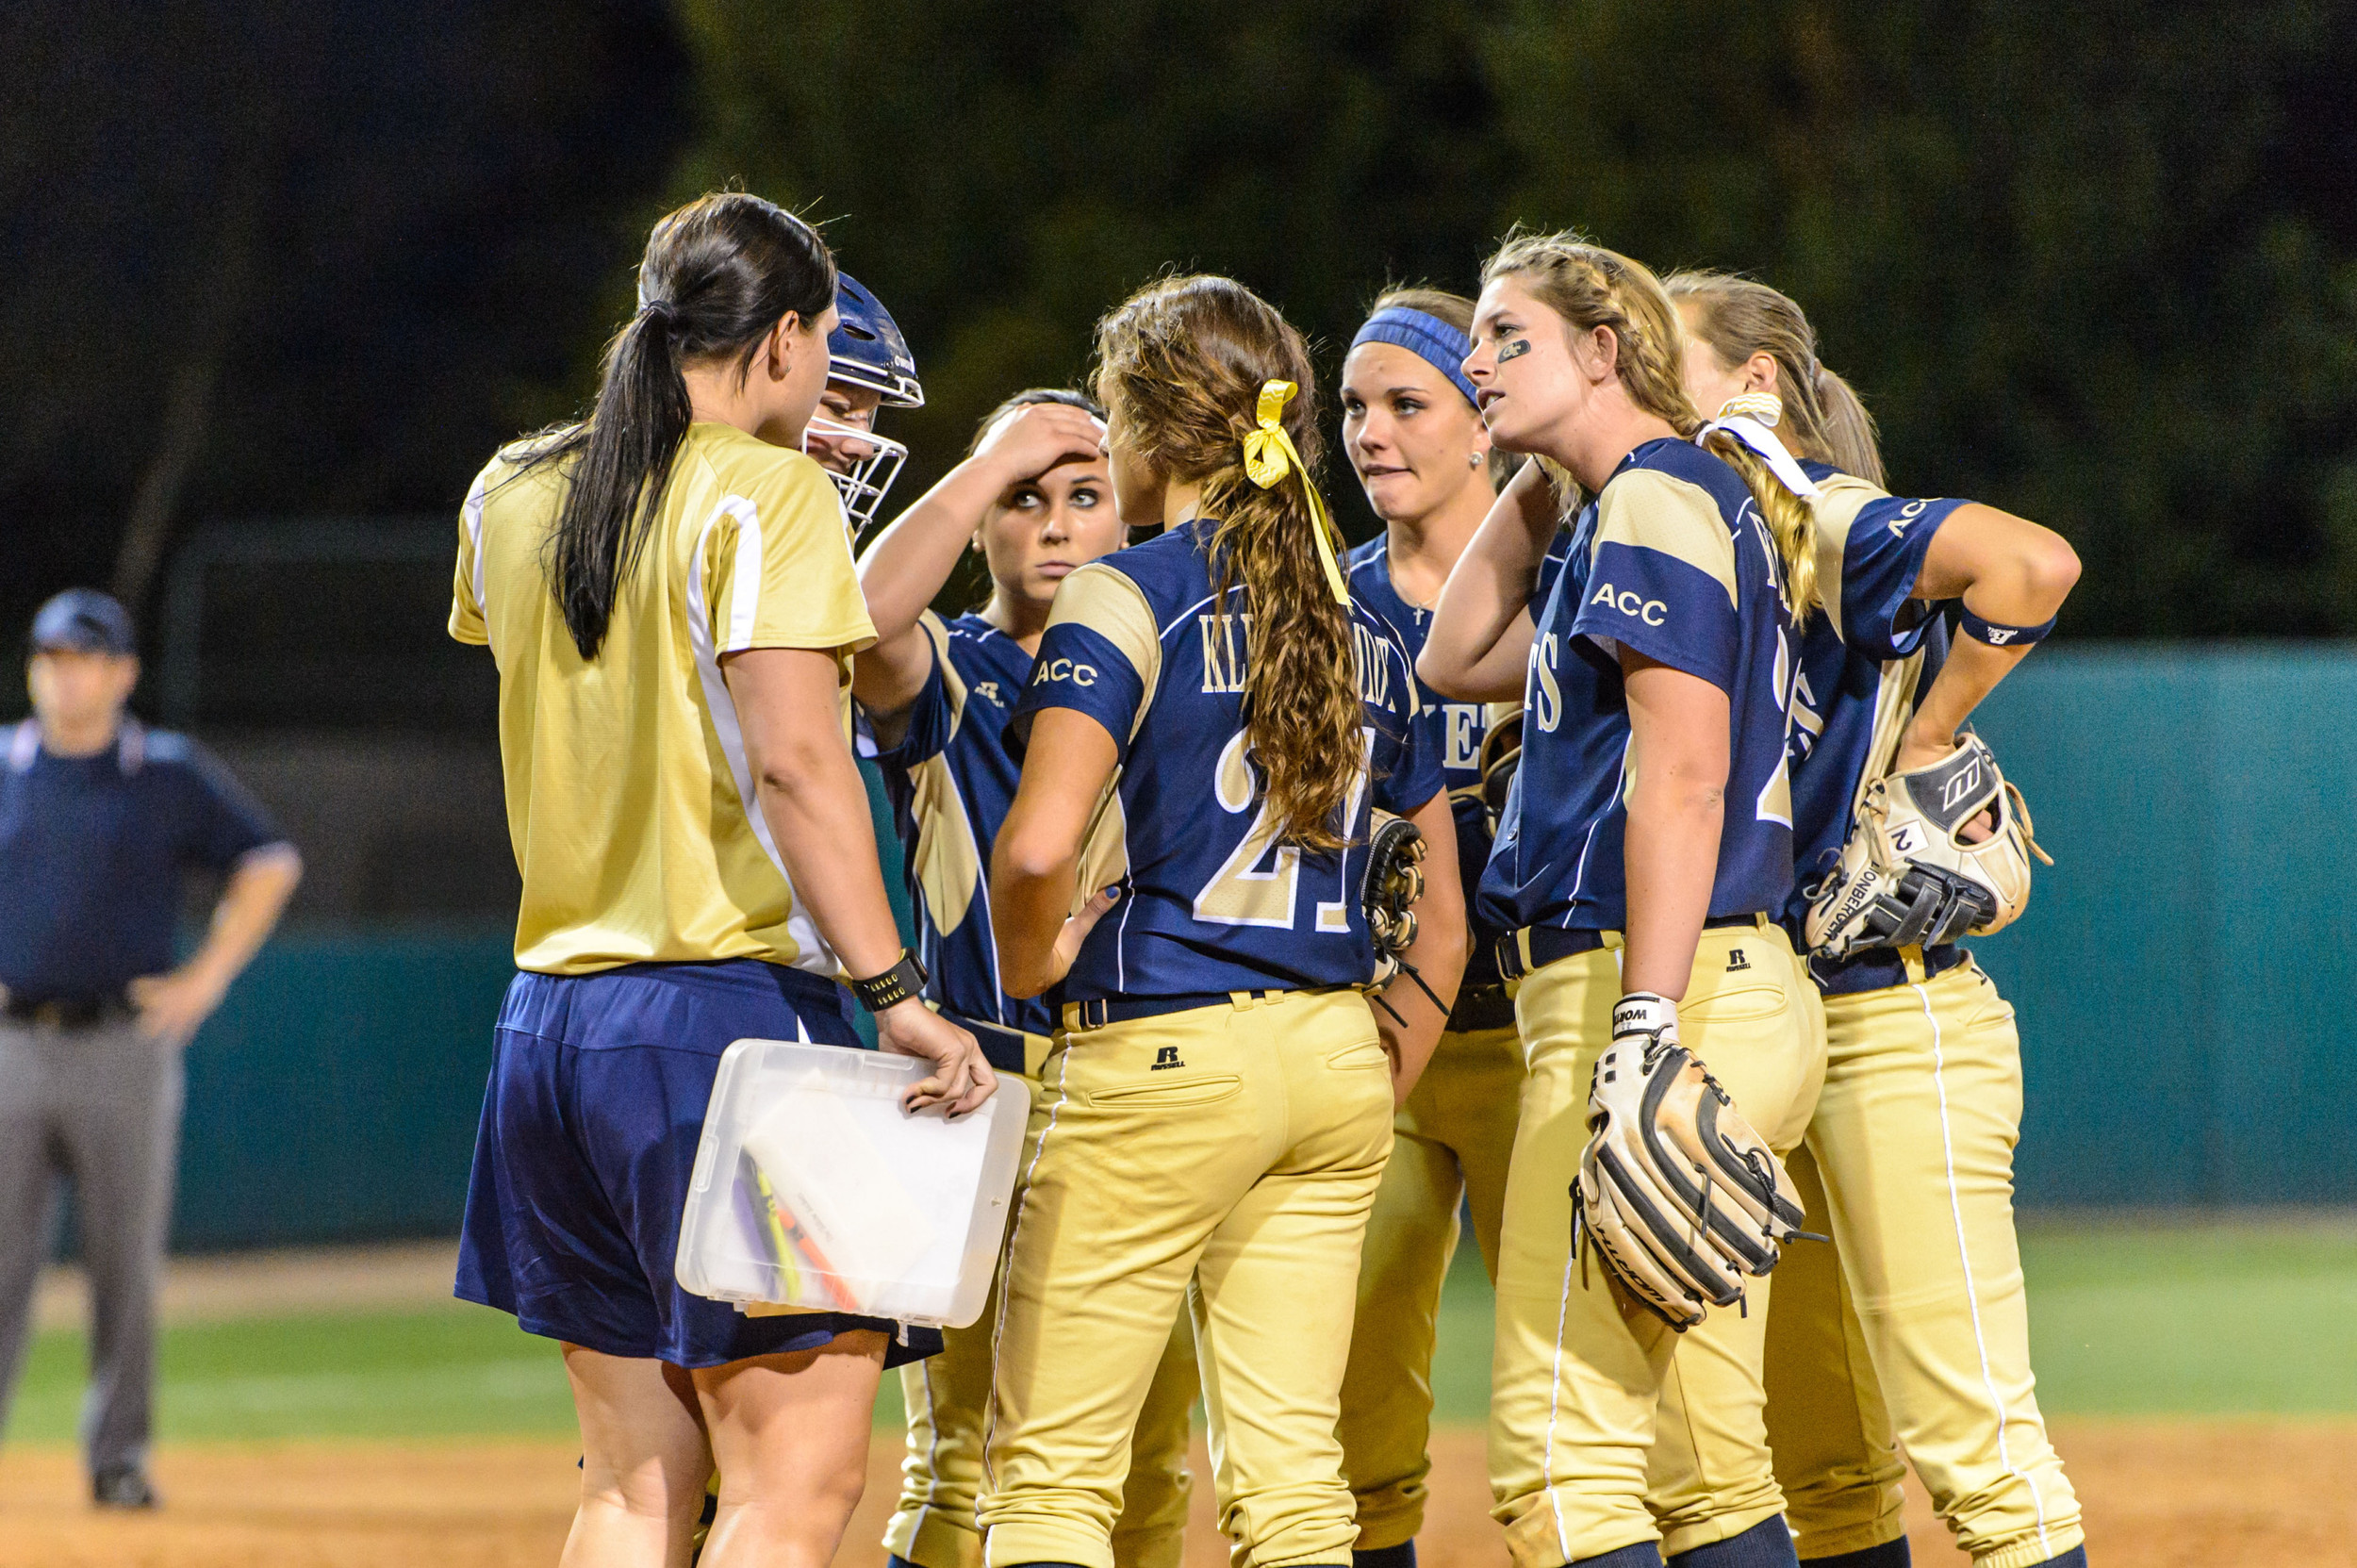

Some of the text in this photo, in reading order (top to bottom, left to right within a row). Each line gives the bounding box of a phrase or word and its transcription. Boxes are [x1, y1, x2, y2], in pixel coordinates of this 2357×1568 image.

[1591, 583, 1668, 626] ACC
[1033, 658, 1098, 686] ACC
[1595, 1226, 1668, 1302] WORTH
